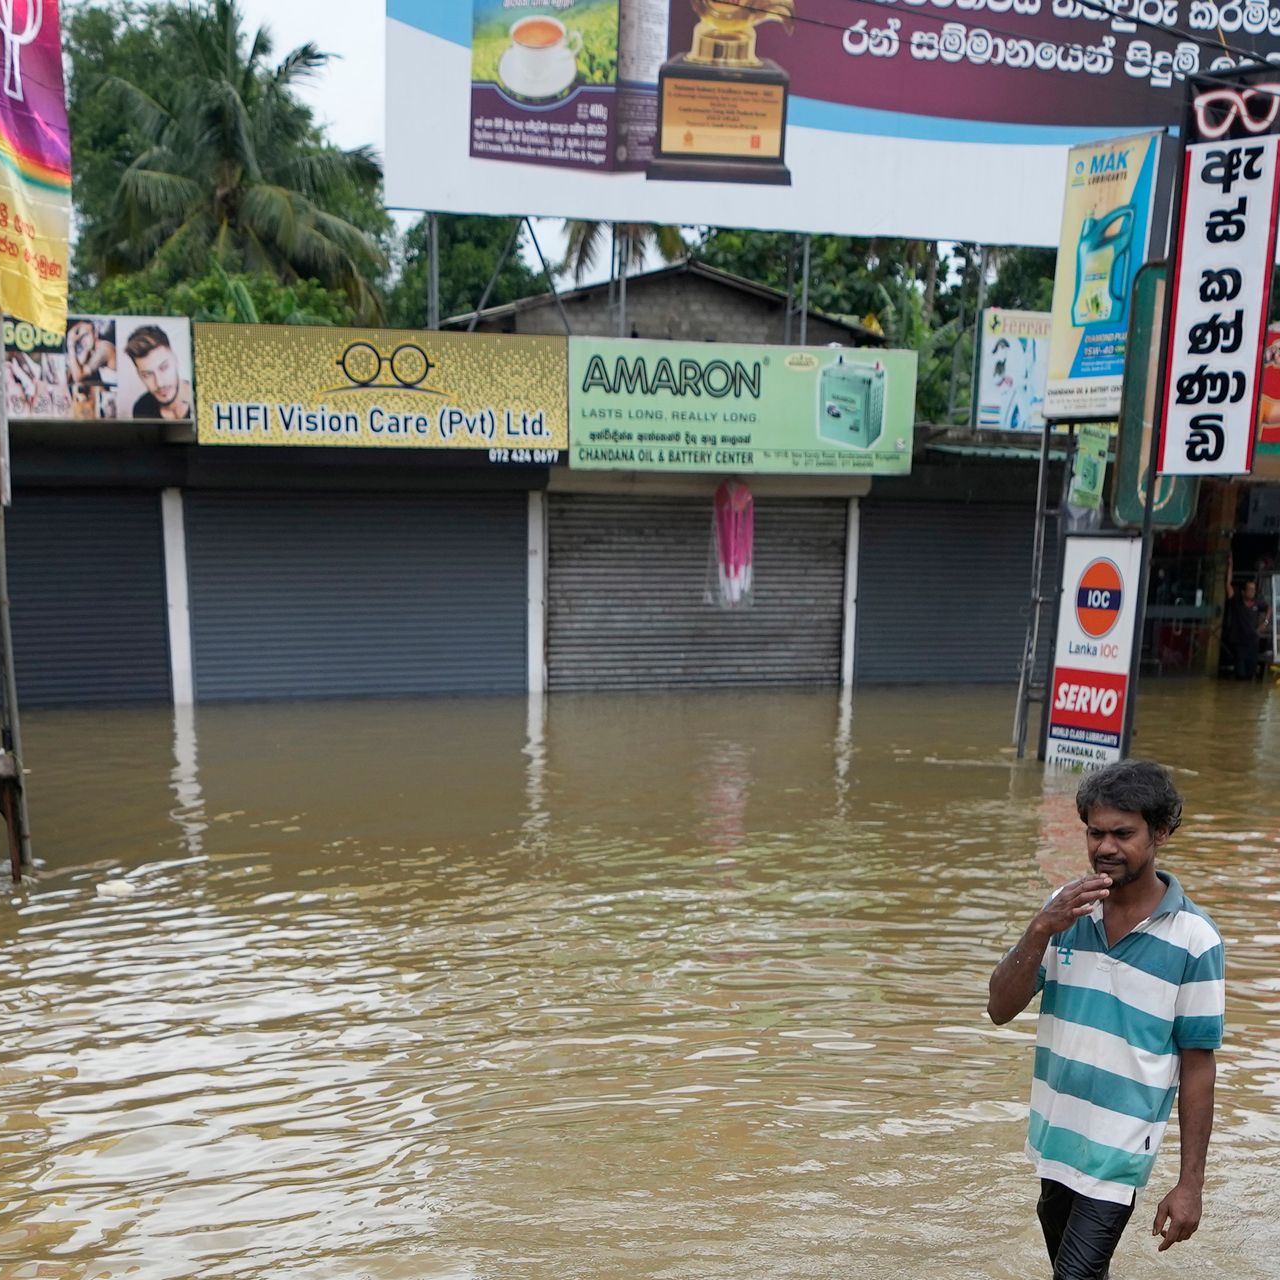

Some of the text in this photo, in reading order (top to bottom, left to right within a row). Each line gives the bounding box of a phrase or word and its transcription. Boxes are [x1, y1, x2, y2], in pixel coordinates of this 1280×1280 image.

[842, 18, 901, 57] රන්
[1090, 150, 1129, 174] MAK
[582, 354, 761, 399] AMARON
[215, 404, 551, 439] HIFI Vision Care (Pvt) Ltd.
[581, 408, 623, 419] LASTS
[671, 410, 718, 422] REALLY
[579, 448, 635, 462] CHANDANA
[638, 449, 653, 462] OIL
[658, 450, 665, 462] &
[669, 450, 711, 463] BATTERY
[715, 451, 754, 464] CENTER
[1087, 590, 1110, 608] IOC
[1068, 640, 1118, 658] Lanka IOC
[1055, 682, 1118, 717] SERVO
[1052, 726, 1117, 746] WORLD CLASS LUBRICANTS
[1057, 743, 1107, 760] CHANDANA OIL
